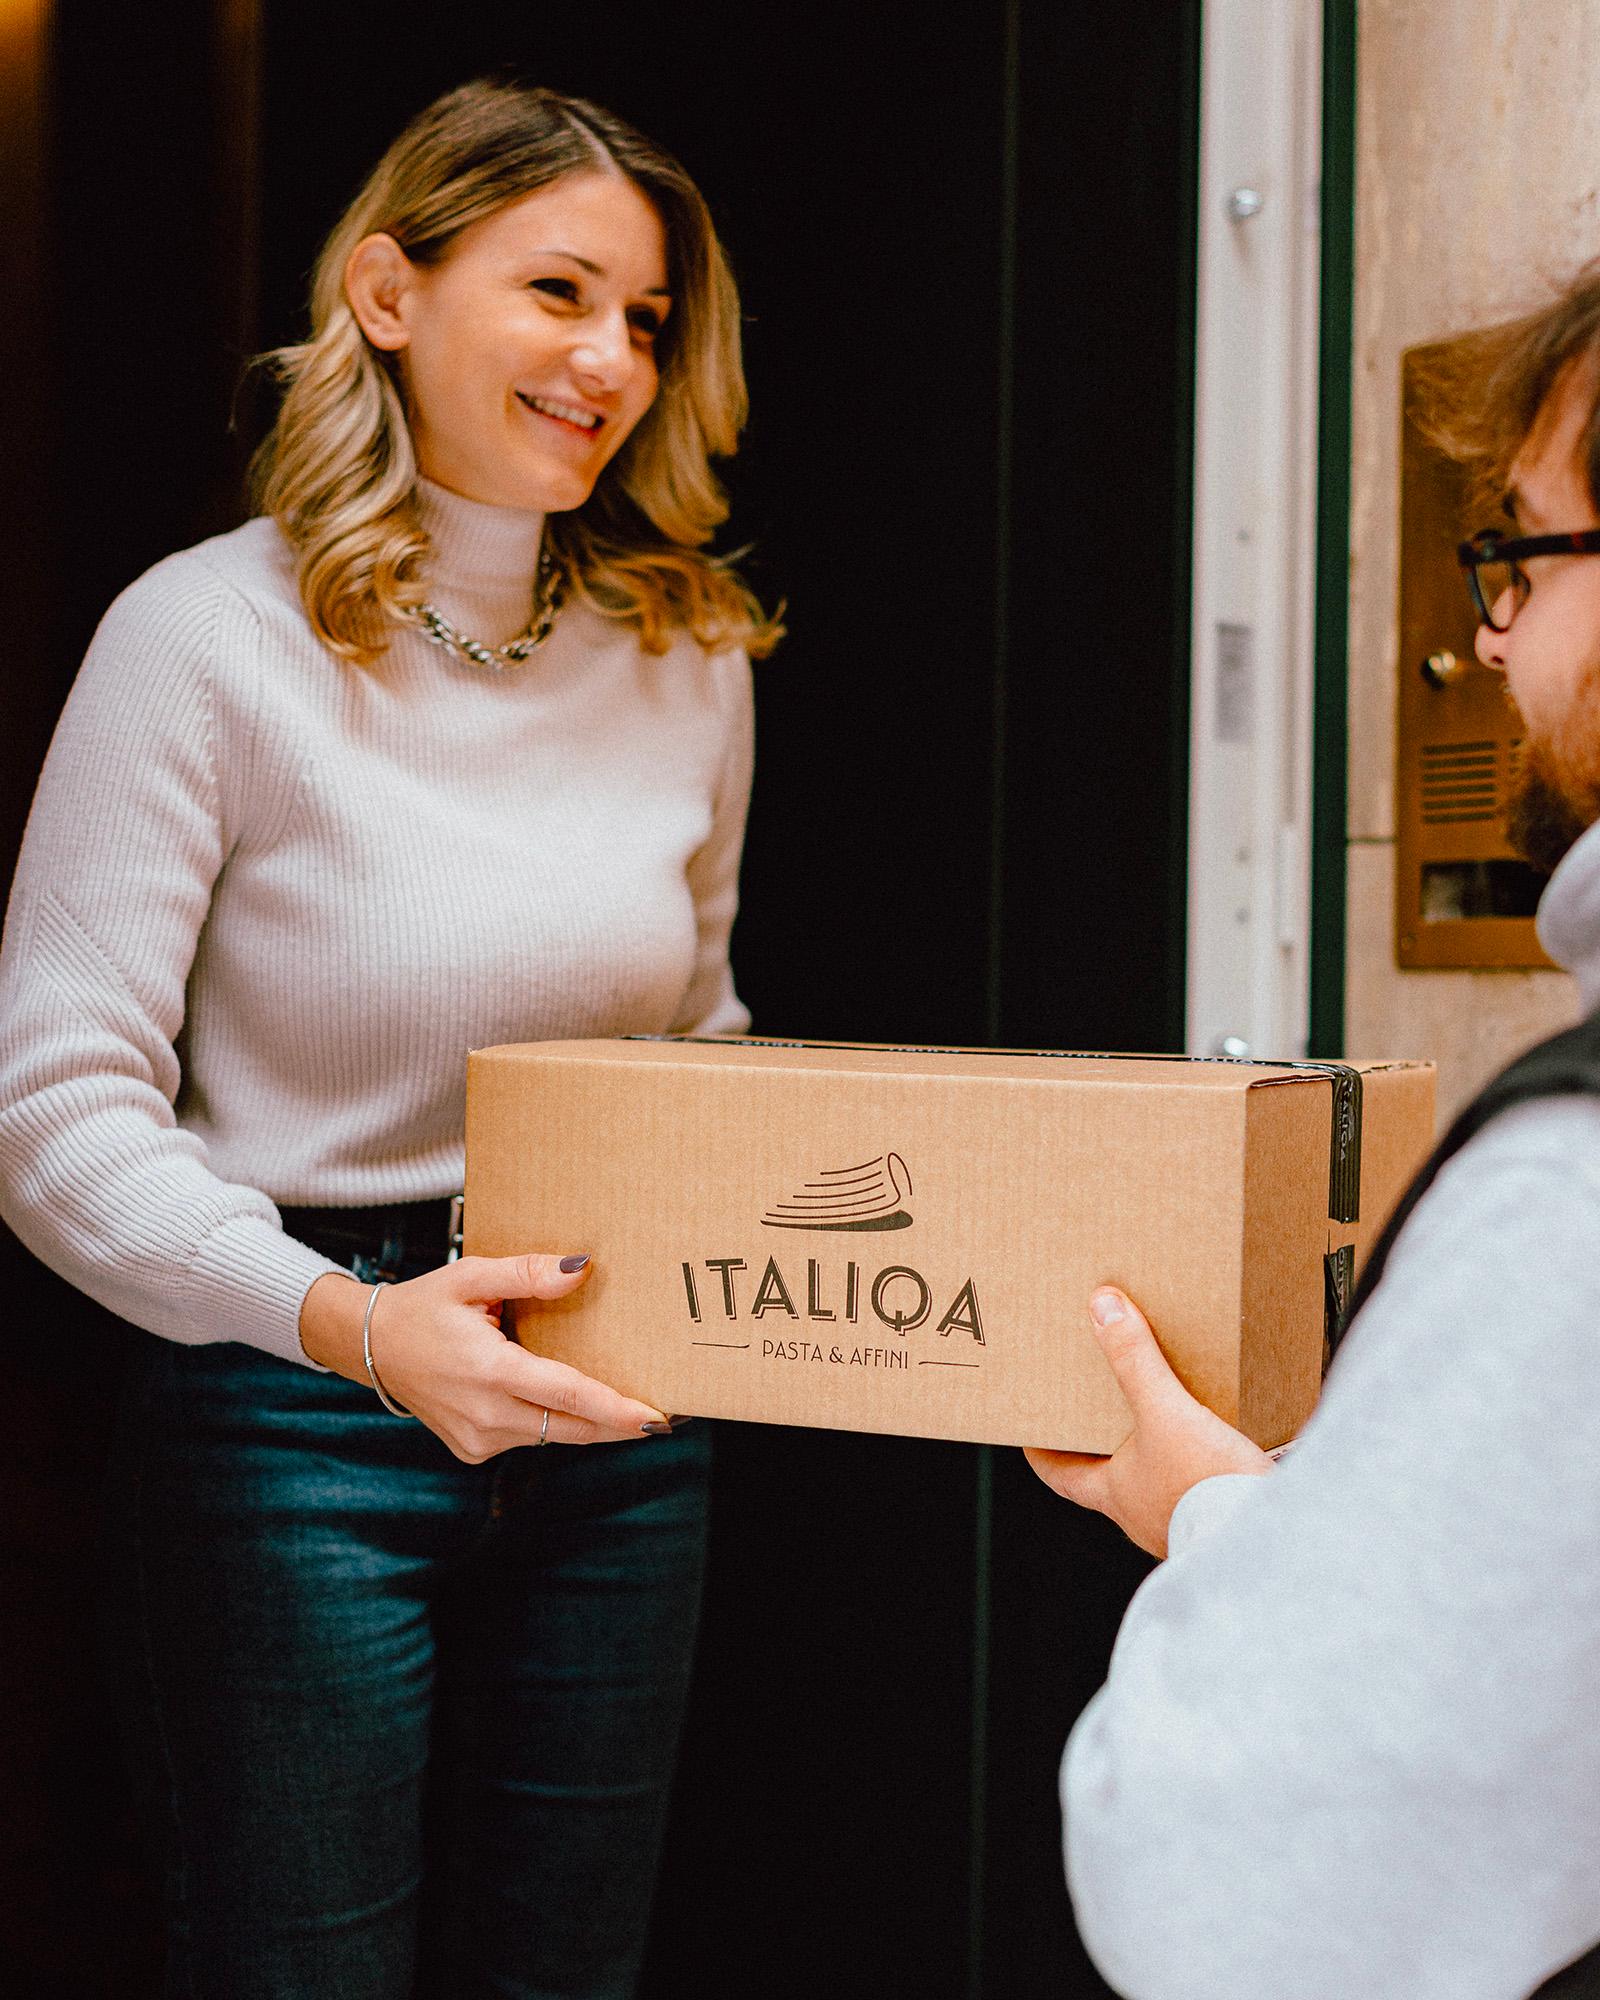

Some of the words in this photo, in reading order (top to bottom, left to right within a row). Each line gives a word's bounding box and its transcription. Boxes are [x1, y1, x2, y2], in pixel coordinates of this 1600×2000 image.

[682, 1255, 986, 1346] ITALIQA
[762, 1339, 823, 1362] PASTA
[829, 1349, 845, 1364] &
[849, 1347, 909, 1369] AFFINI
